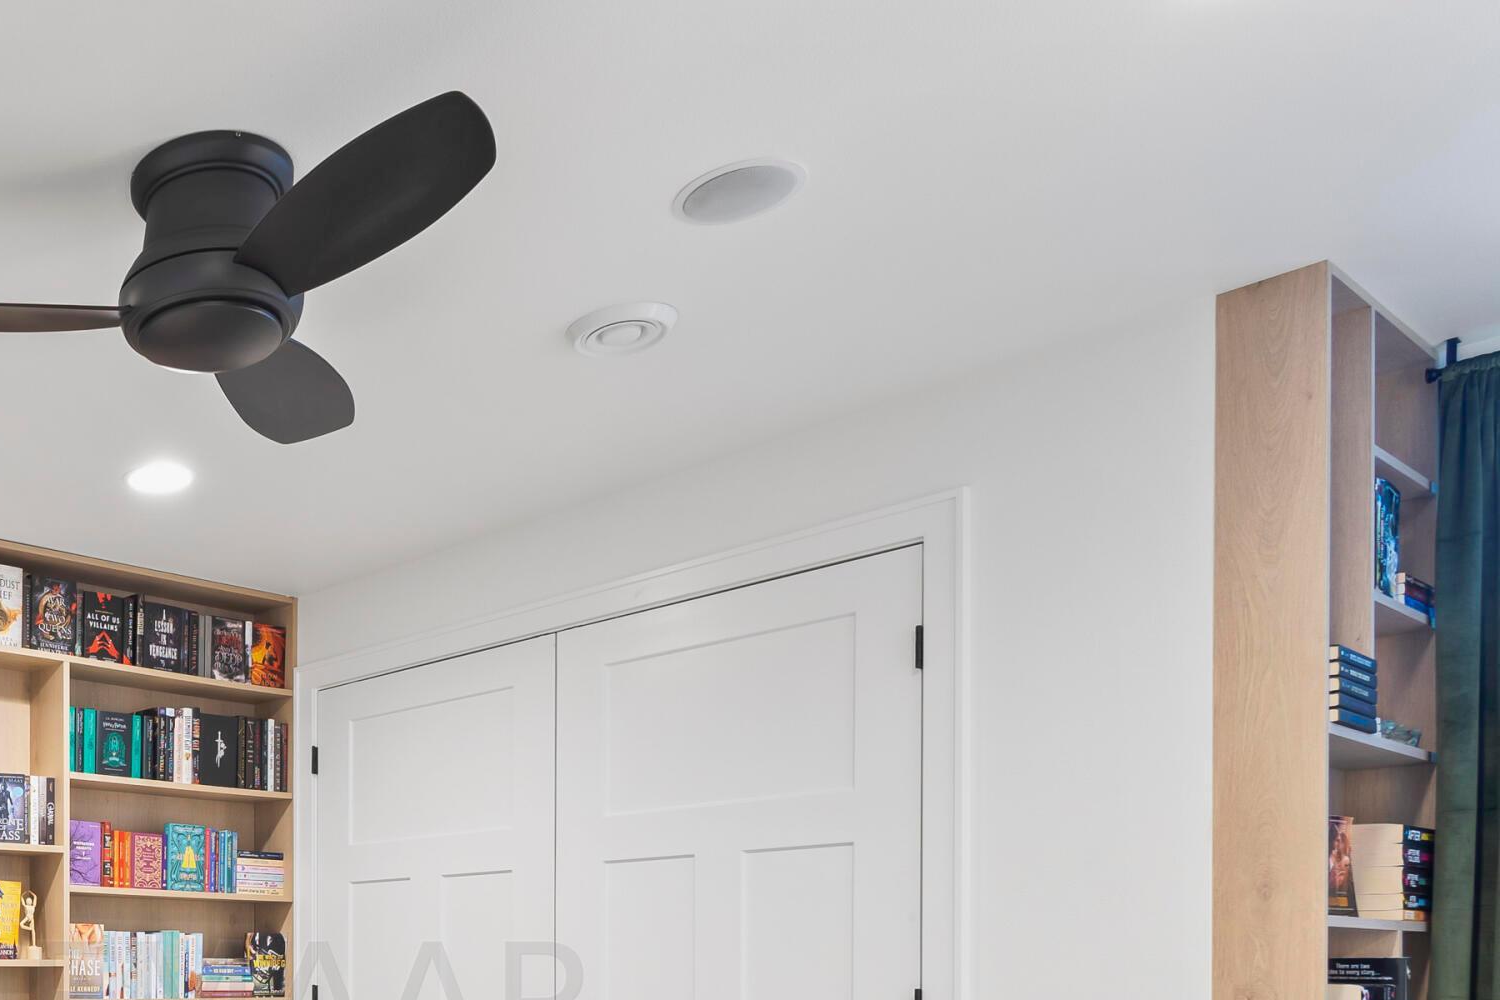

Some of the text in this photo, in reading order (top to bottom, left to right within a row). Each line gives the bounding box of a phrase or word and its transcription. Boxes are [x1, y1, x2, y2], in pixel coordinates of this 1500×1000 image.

[86, 612, 99, 621] ALL
[89, 620, 118, 632] VILLAINS
[154, 619, 174, 634] LESSON
[149, 644, 178, 660] VENGEANCE
[77, 985, 101, 993] KENNEDY
